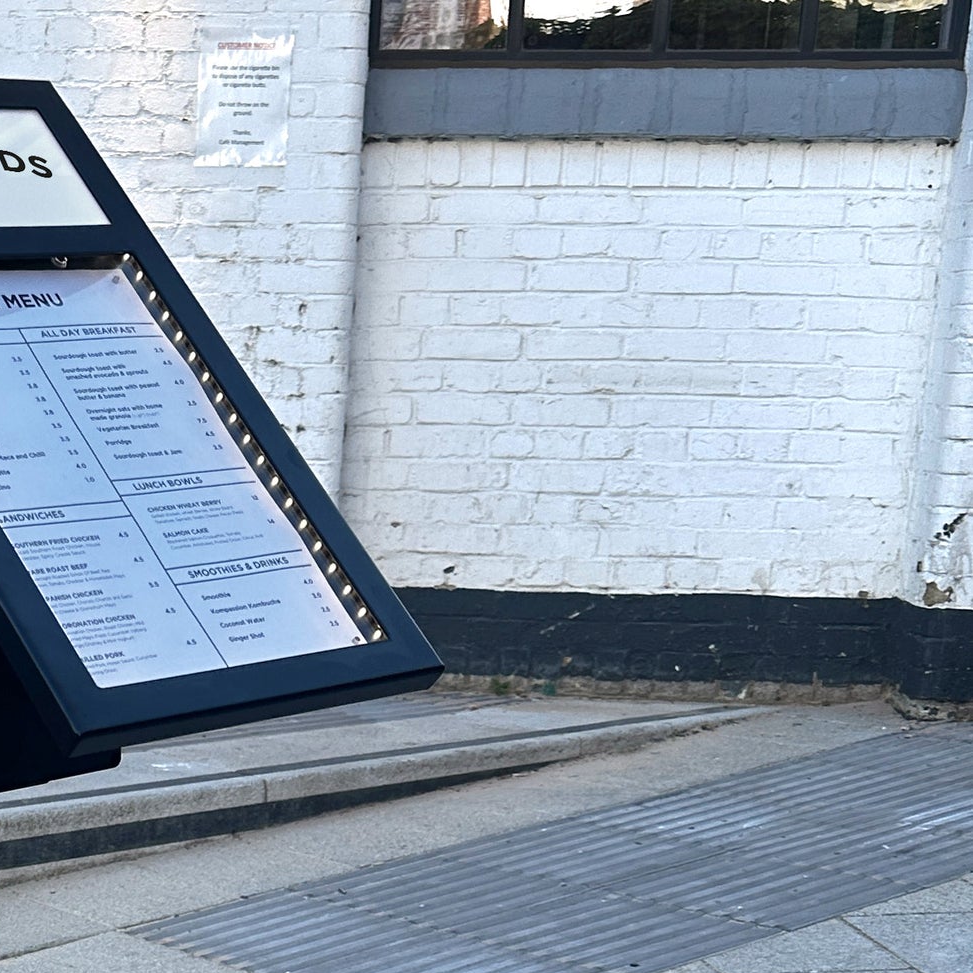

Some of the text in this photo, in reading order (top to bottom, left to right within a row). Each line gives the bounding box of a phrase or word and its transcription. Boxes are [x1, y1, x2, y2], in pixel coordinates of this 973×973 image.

[1, 293, 64, 309] MENU
[61, 329, 80, 337] DAY
[83, 326, 137, 336] BREAKFAST
[132, 477, 202, 490] LUNCH BOWLS
[163, 530, 191, 538] SALMON
[46, 565, 69, 573] ROAST
[188, 564, 243, 579] SMOOTHIES
[254, 557, 289, 568] DRINKS
[46, 593, 71, 602] PANISH
[72, 589, 104, 599] CHICKEN
[202, 592, 231, 601] Smoothie
[210, 604, 246, 614] Kompassion
[247, 599, 281, 609] Kombucha
[62, 619, 104, 629] ORONATION
[105, 614, 136, 623] CHICKEN
[220, 620, 246, 628] Coconut
[228, 634, 249, 643] Ginger
[81, 654, 104, 662] LLED
